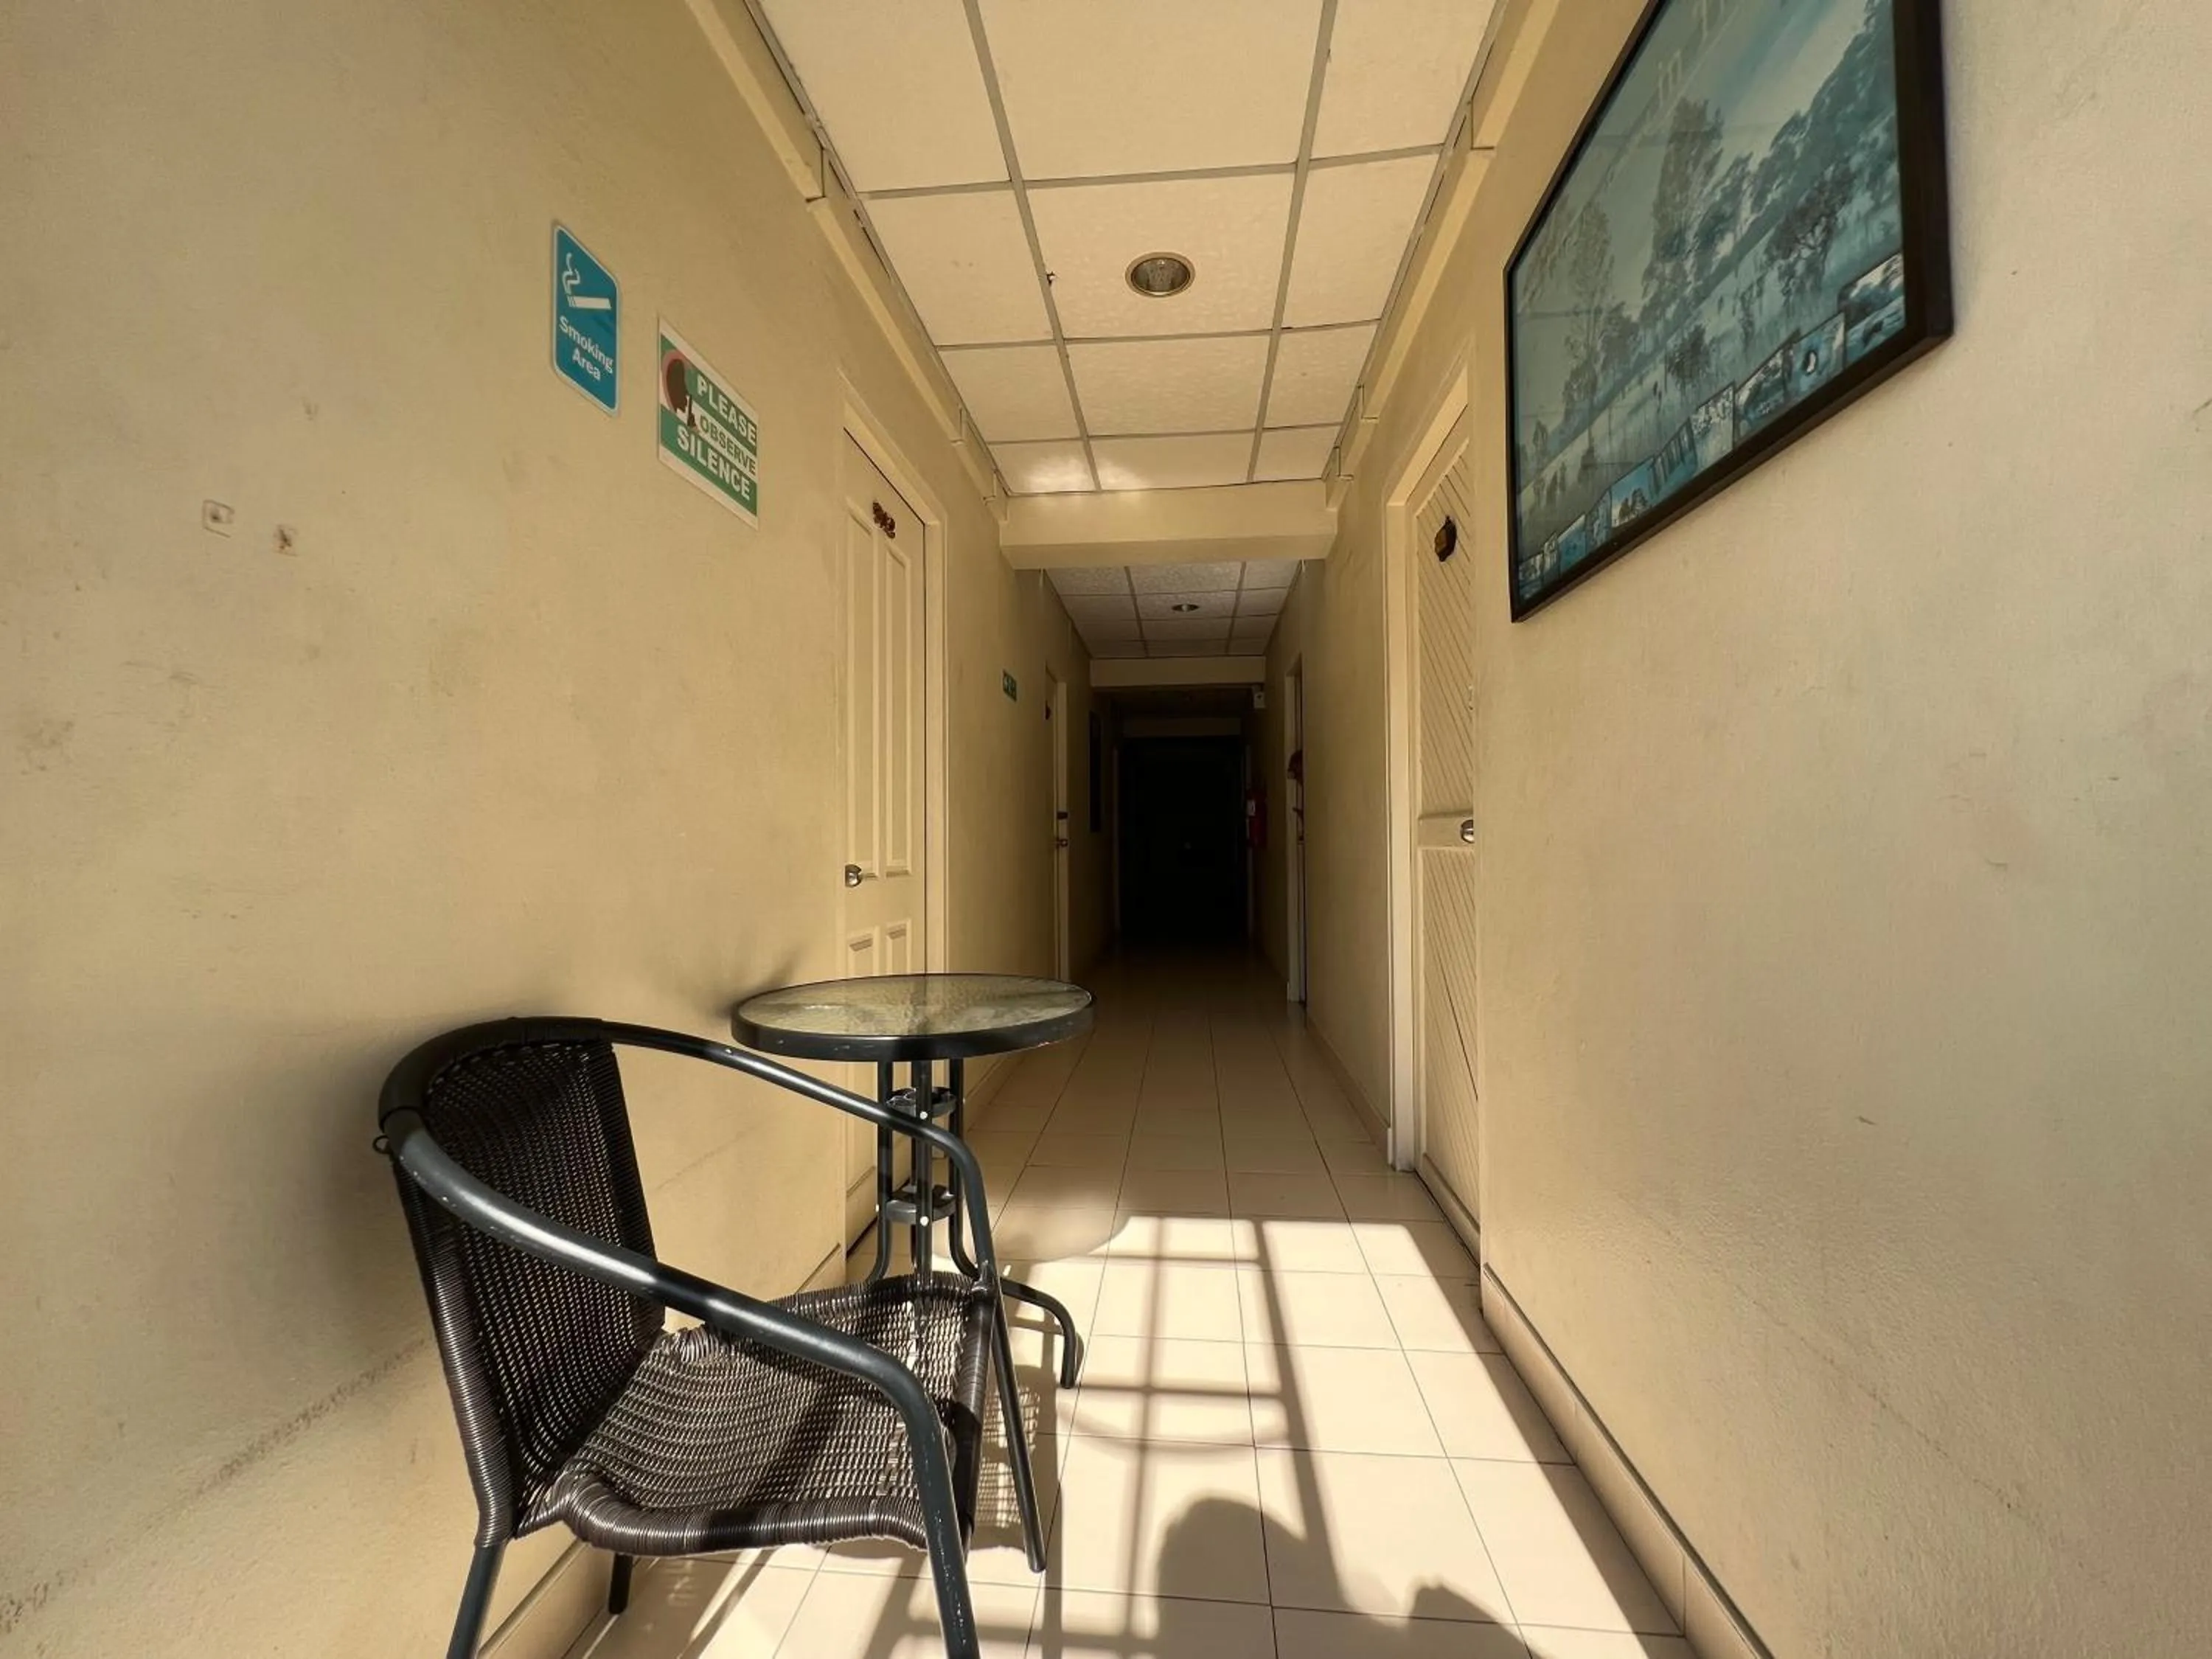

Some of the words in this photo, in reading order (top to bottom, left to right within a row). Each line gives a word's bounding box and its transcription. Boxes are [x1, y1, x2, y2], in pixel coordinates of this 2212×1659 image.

[560, 315, 613, 374] Smoking
[572, 348, 601, 380] Area
[697, 374, 757, 446] PLEASE
[677, 424, 750, 501] SILENCE
[700, 415, 756, 476] OBSERVE
